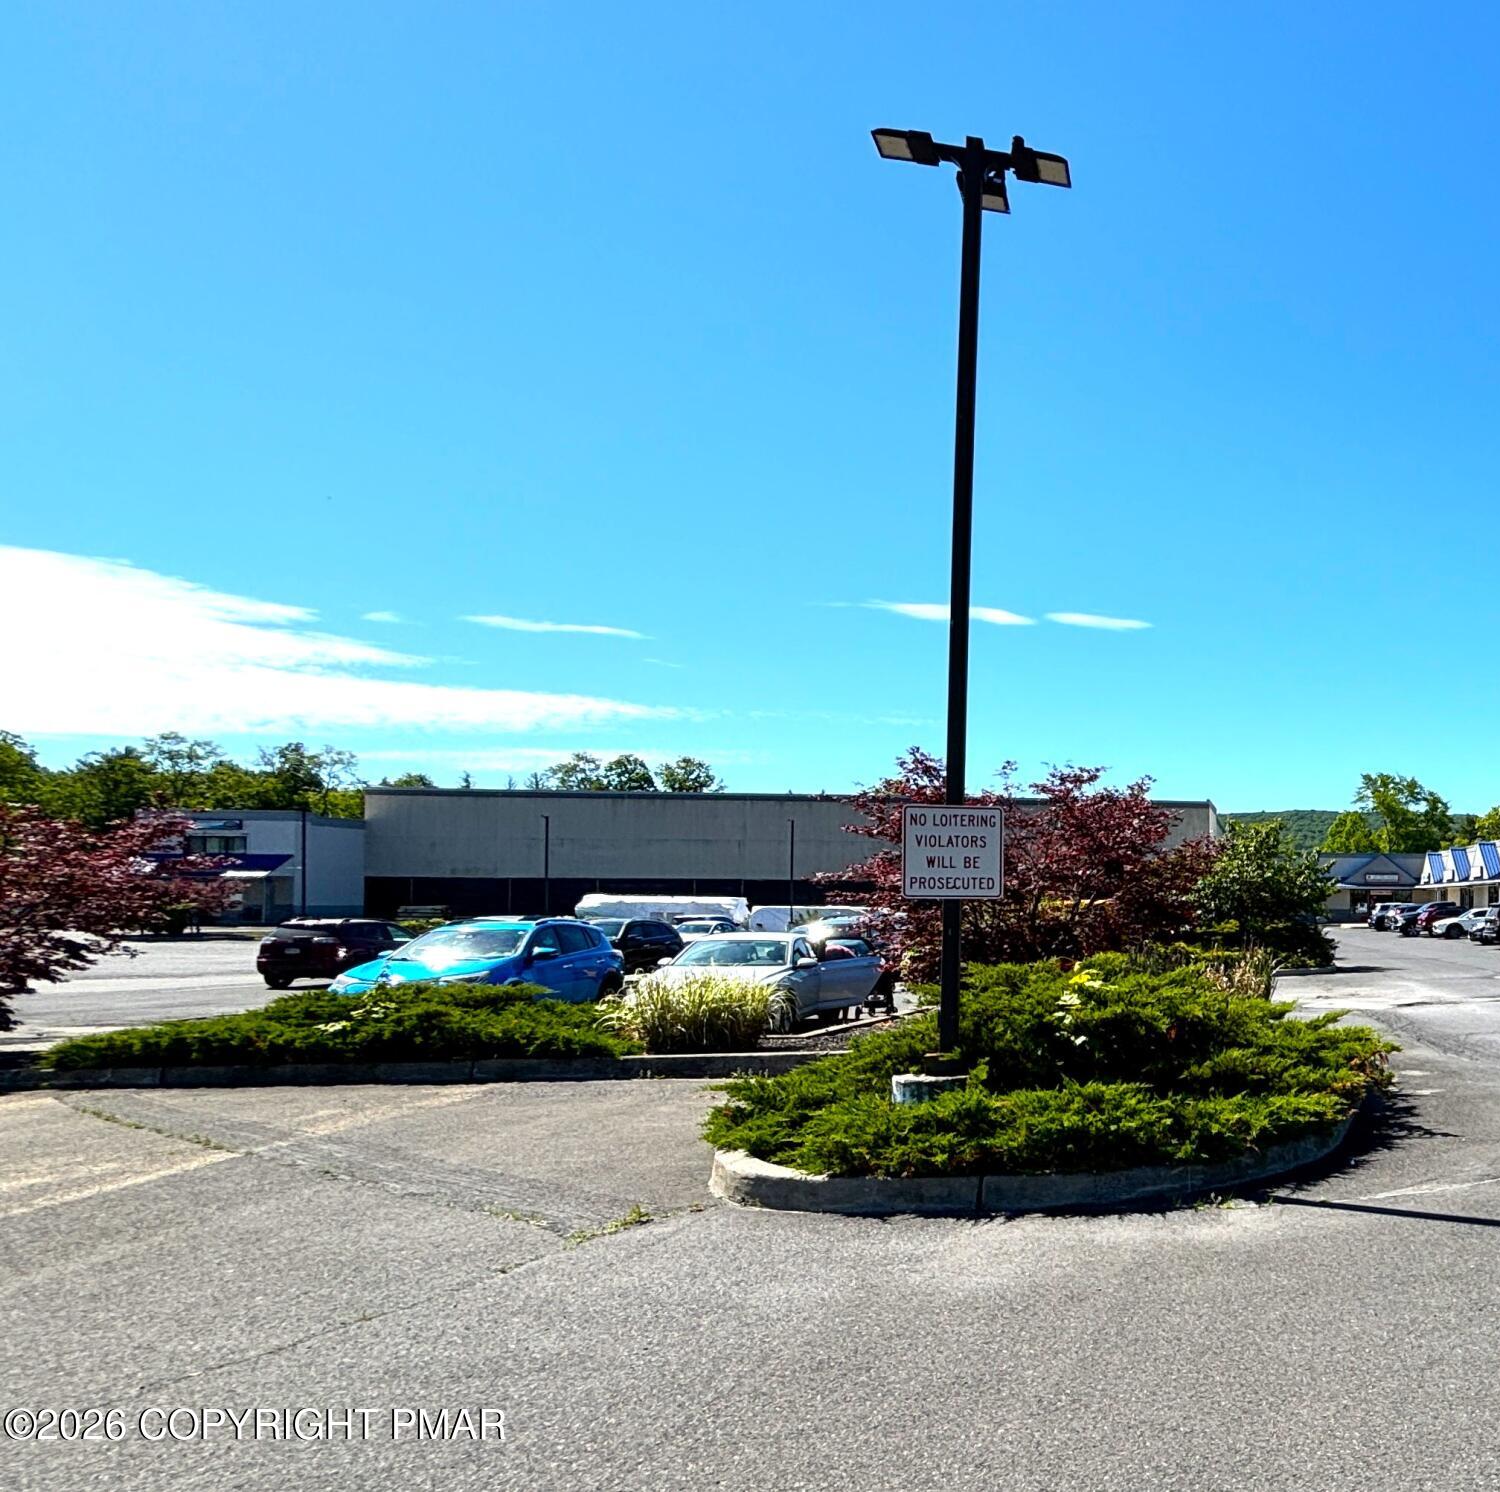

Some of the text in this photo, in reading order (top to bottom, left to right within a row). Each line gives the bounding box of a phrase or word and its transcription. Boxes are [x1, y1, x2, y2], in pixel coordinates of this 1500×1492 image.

[909, 813, 997, 828] NO LOITERING
[915, 834, 987, 848] VIOLATORS
[925, 855, 980, 869] WILL BE
[909, 877, 995, 890] PROSECUTED
